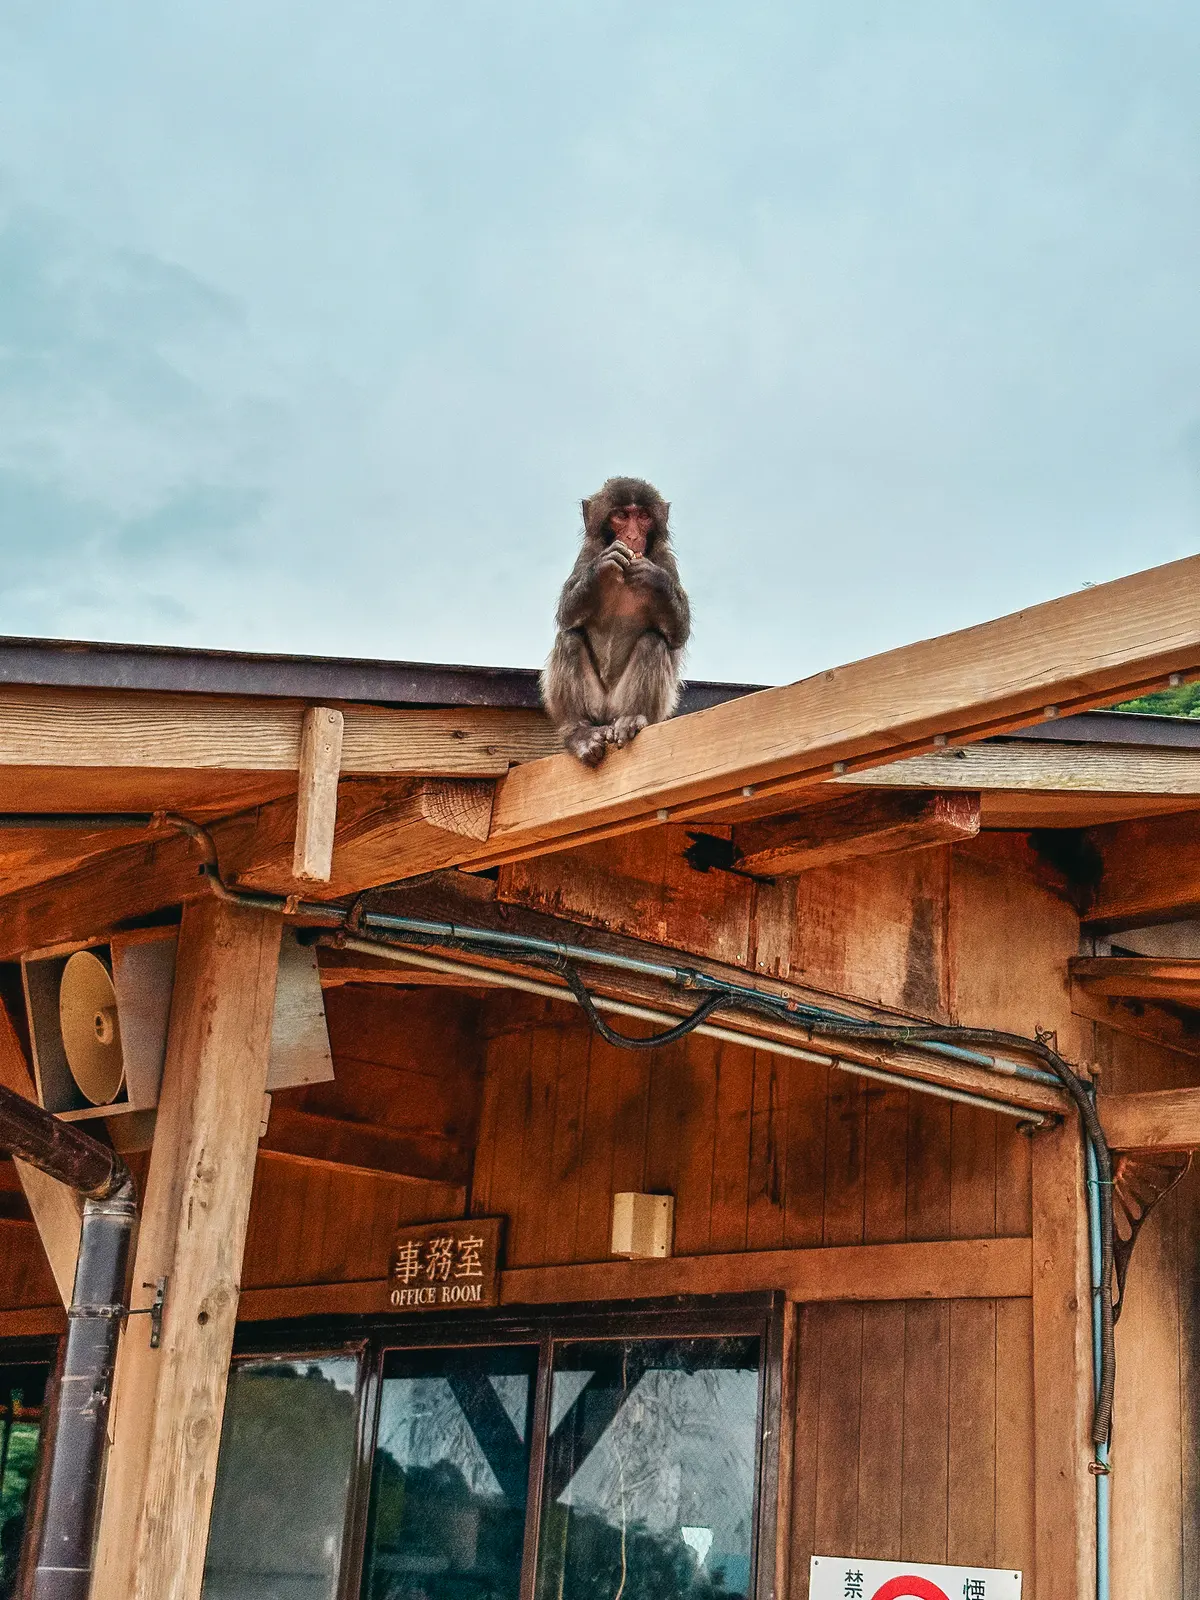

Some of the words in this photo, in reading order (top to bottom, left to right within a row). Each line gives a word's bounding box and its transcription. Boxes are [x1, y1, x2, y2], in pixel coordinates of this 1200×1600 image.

[395, 1235, 485, 1284] 事務室
[391, 1287, 436, 1306] OFFICE
[442, 1284, 482, 1303] ROOM
[844, 1569, 864, 1598] 禁
